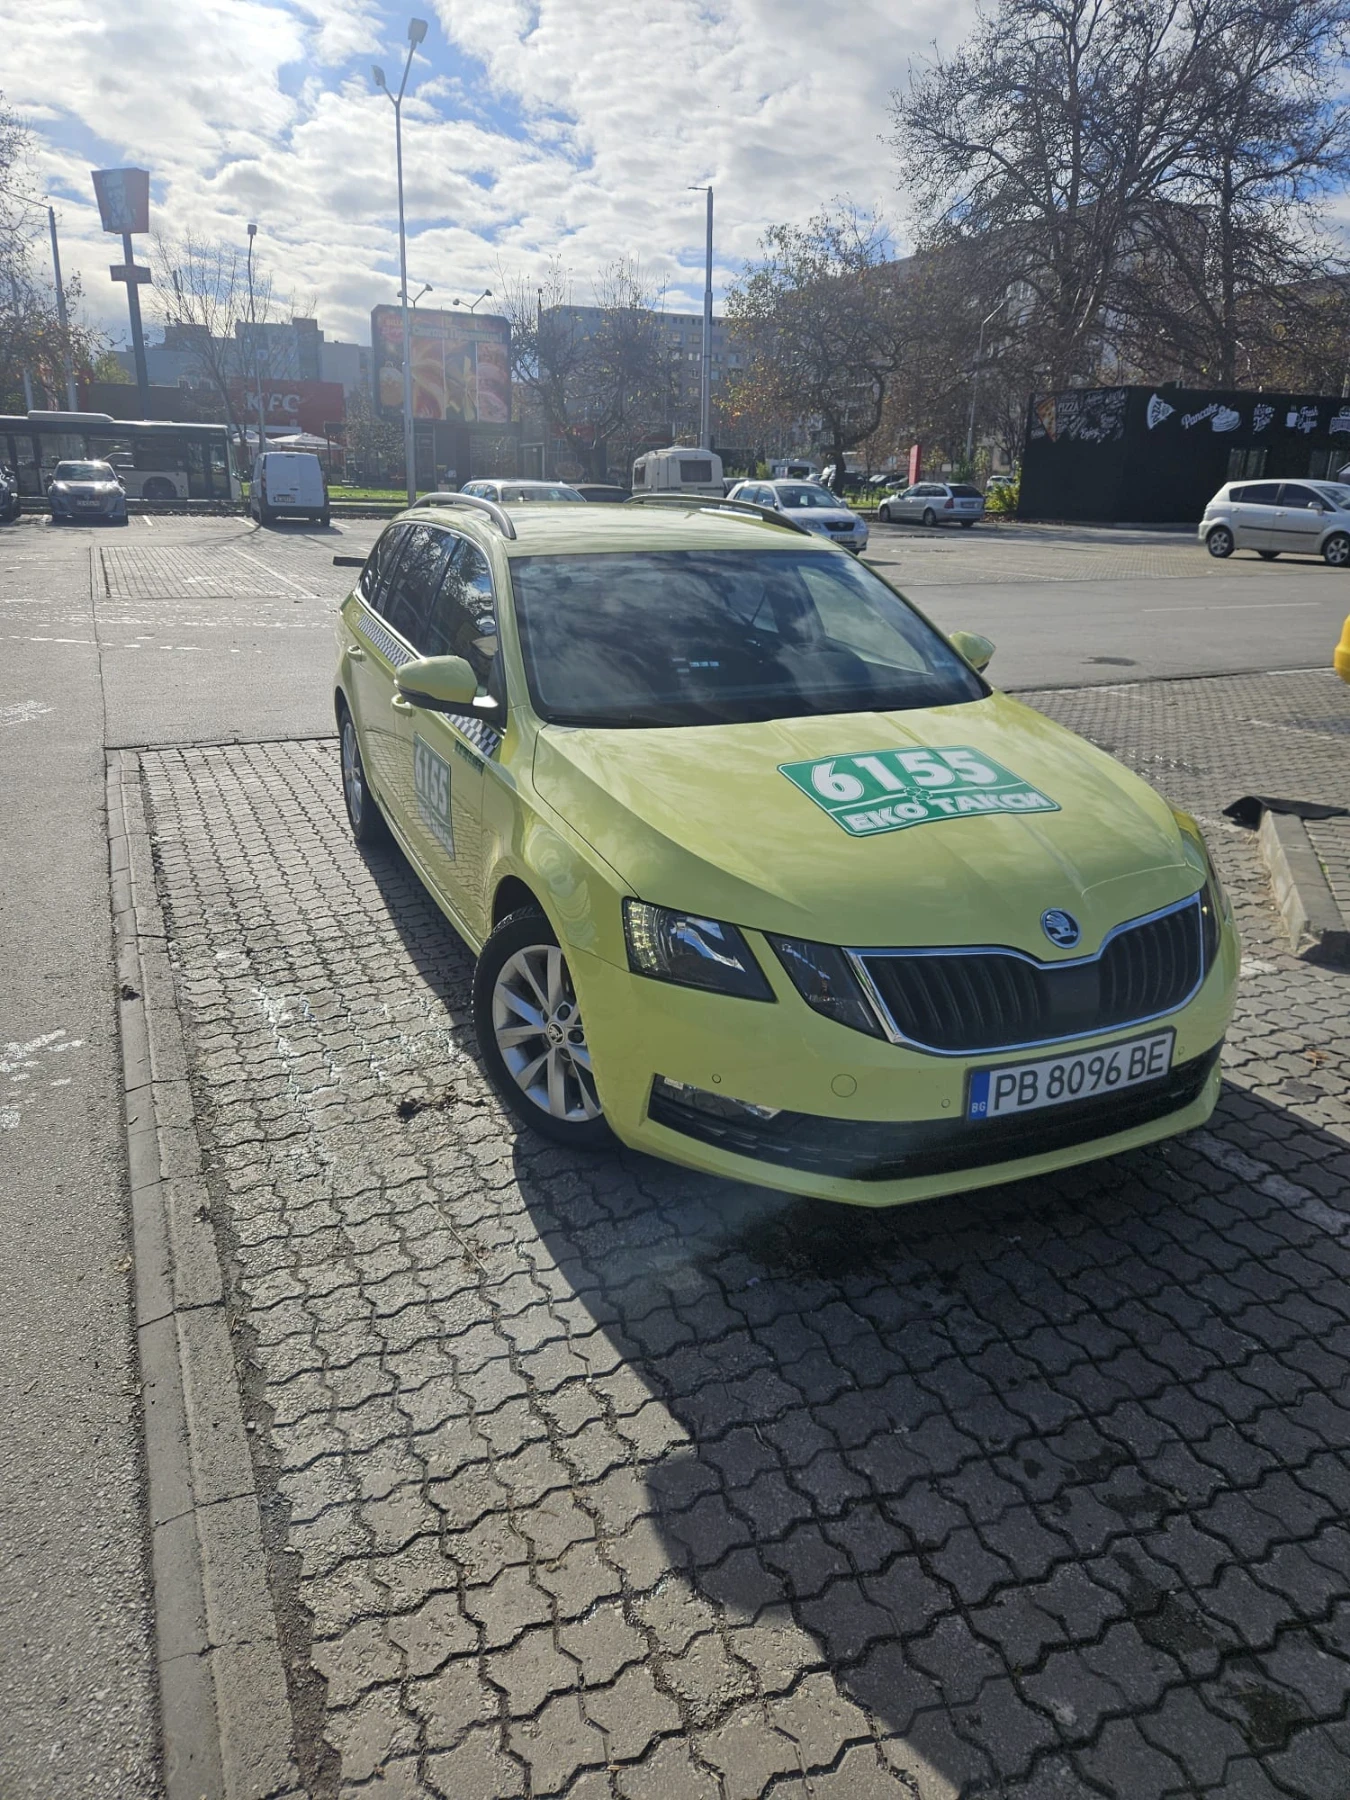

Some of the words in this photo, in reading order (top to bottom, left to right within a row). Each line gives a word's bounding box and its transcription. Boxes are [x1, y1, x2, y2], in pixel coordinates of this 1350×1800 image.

[246, 391, 300, 413] KFC
[1058, 402, 1079, 413] PIZZA
[1181, 403, 1218, 429] Pancake
[416, 746, 448, 816] 6155
[811, 750, 998, 802] 6155
[842, 802, 928, 832] ЕКО
[930, 792, 1053, 813] ТАКСИ
[994, 1069, 1039, 1111] PB
[1046, 1051, 1122, 1099] 8096
[1127, 1039, 1167, 1081] BE
[971, 1102, 986, 1113] BG
